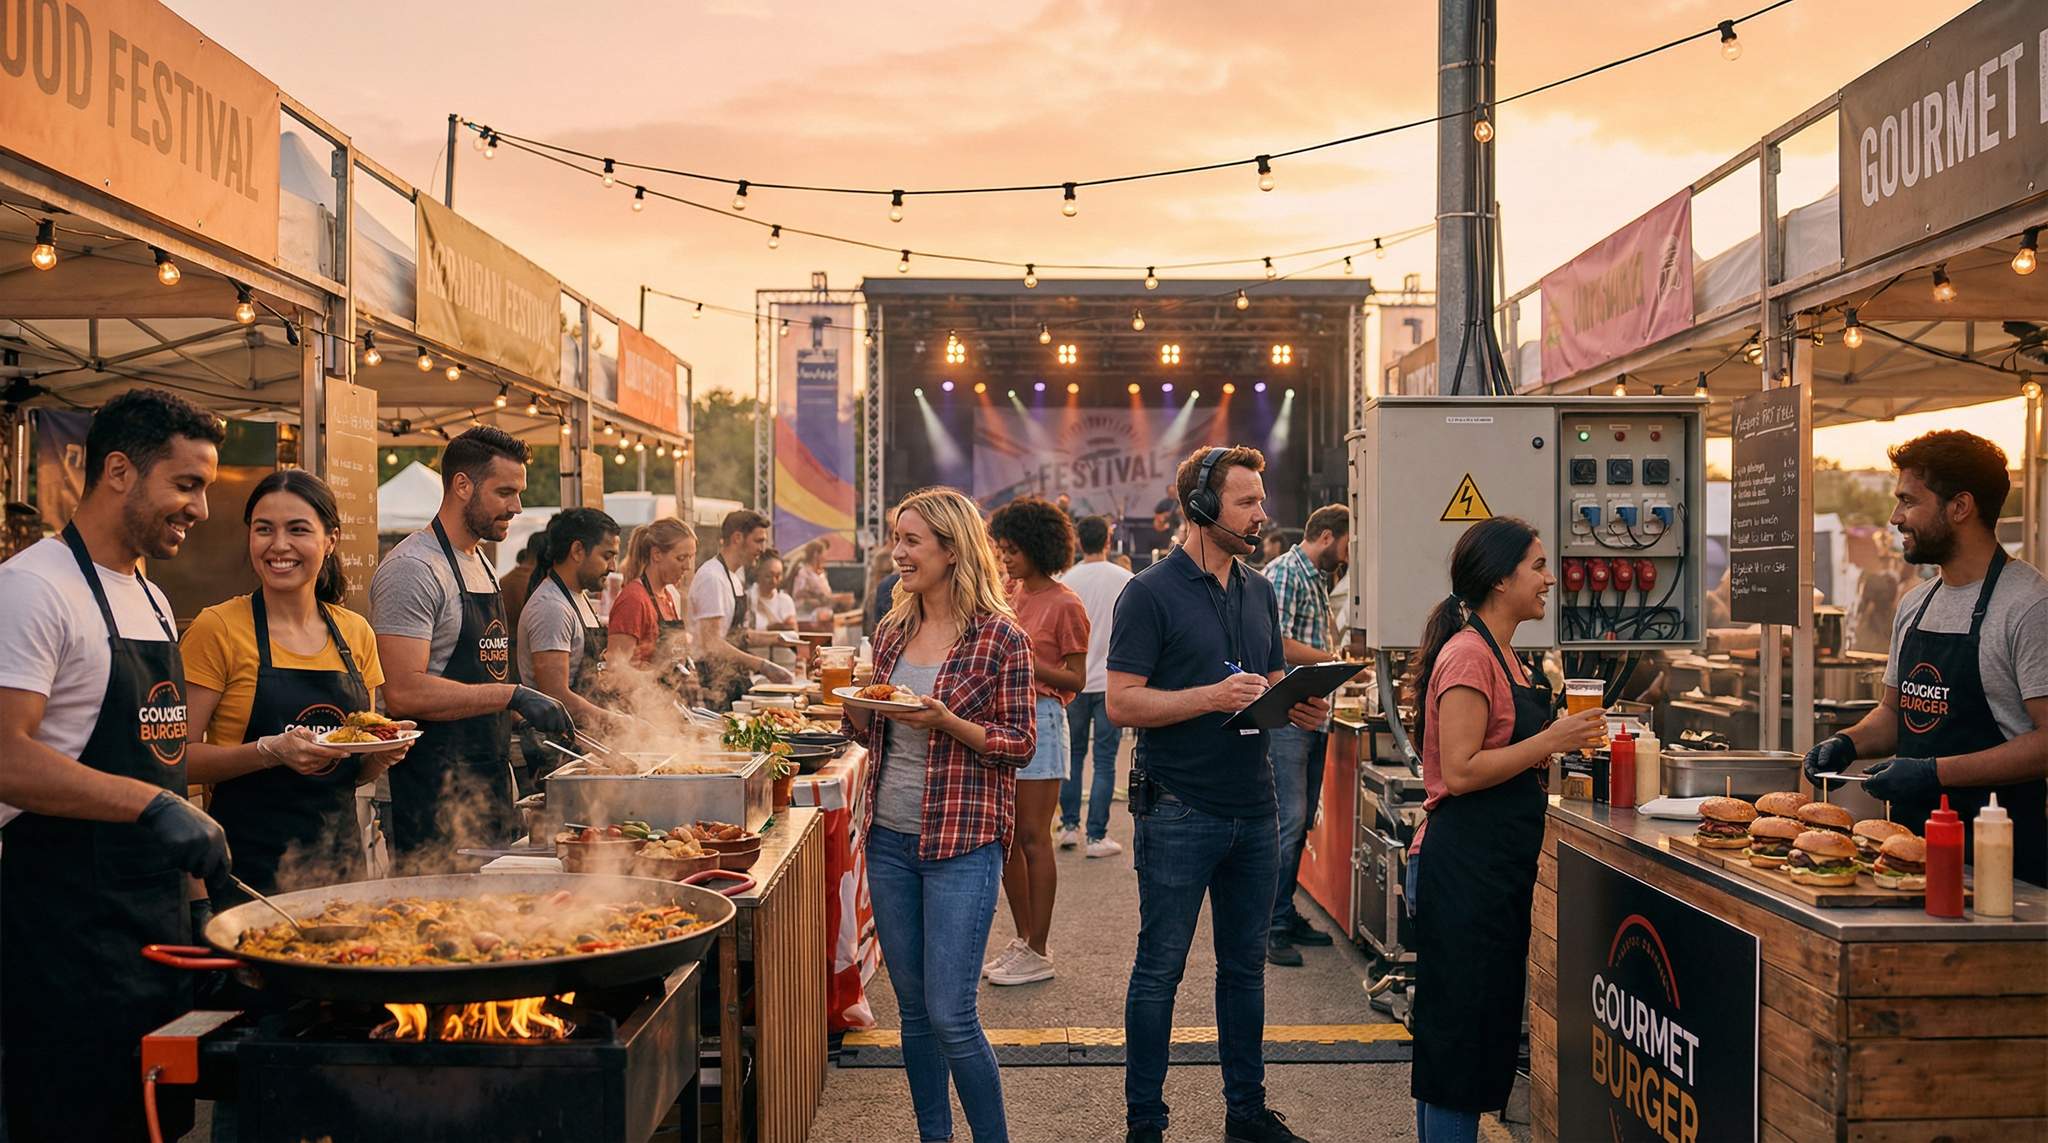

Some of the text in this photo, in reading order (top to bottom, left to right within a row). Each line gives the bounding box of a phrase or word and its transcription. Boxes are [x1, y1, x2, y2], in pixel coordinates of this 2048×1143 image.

[107, 29, 259, 203] FESTIVAL
[1860, 42, 2024, 207] GOURMET
[1039, 450, 1163, 491] FESTIVAL
[140, 722, 188, 741] BURGER
[1899, 694, 1950, 715] BURGER
[1591, 974, 1699, 1087] GOURMET
[1591, 1023, 1699, 1143] BURGER
